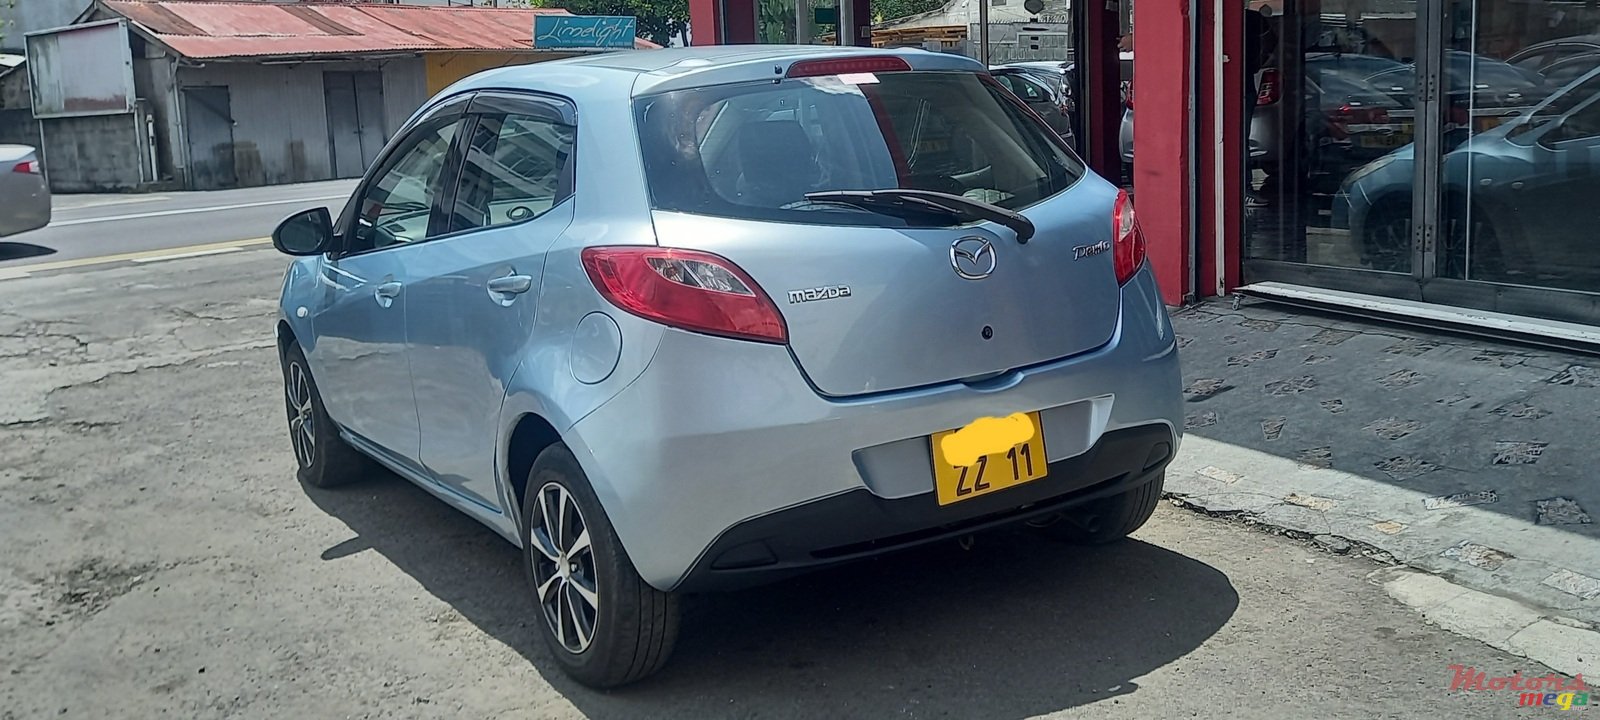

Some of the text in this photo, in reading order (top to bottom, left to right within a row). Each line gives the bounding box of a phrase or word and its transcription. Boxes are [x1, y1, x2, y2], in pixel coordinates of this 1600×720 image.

[537, 18, 634, 46] Limelight
[953, 443, 1033, 496] ZZ 11
